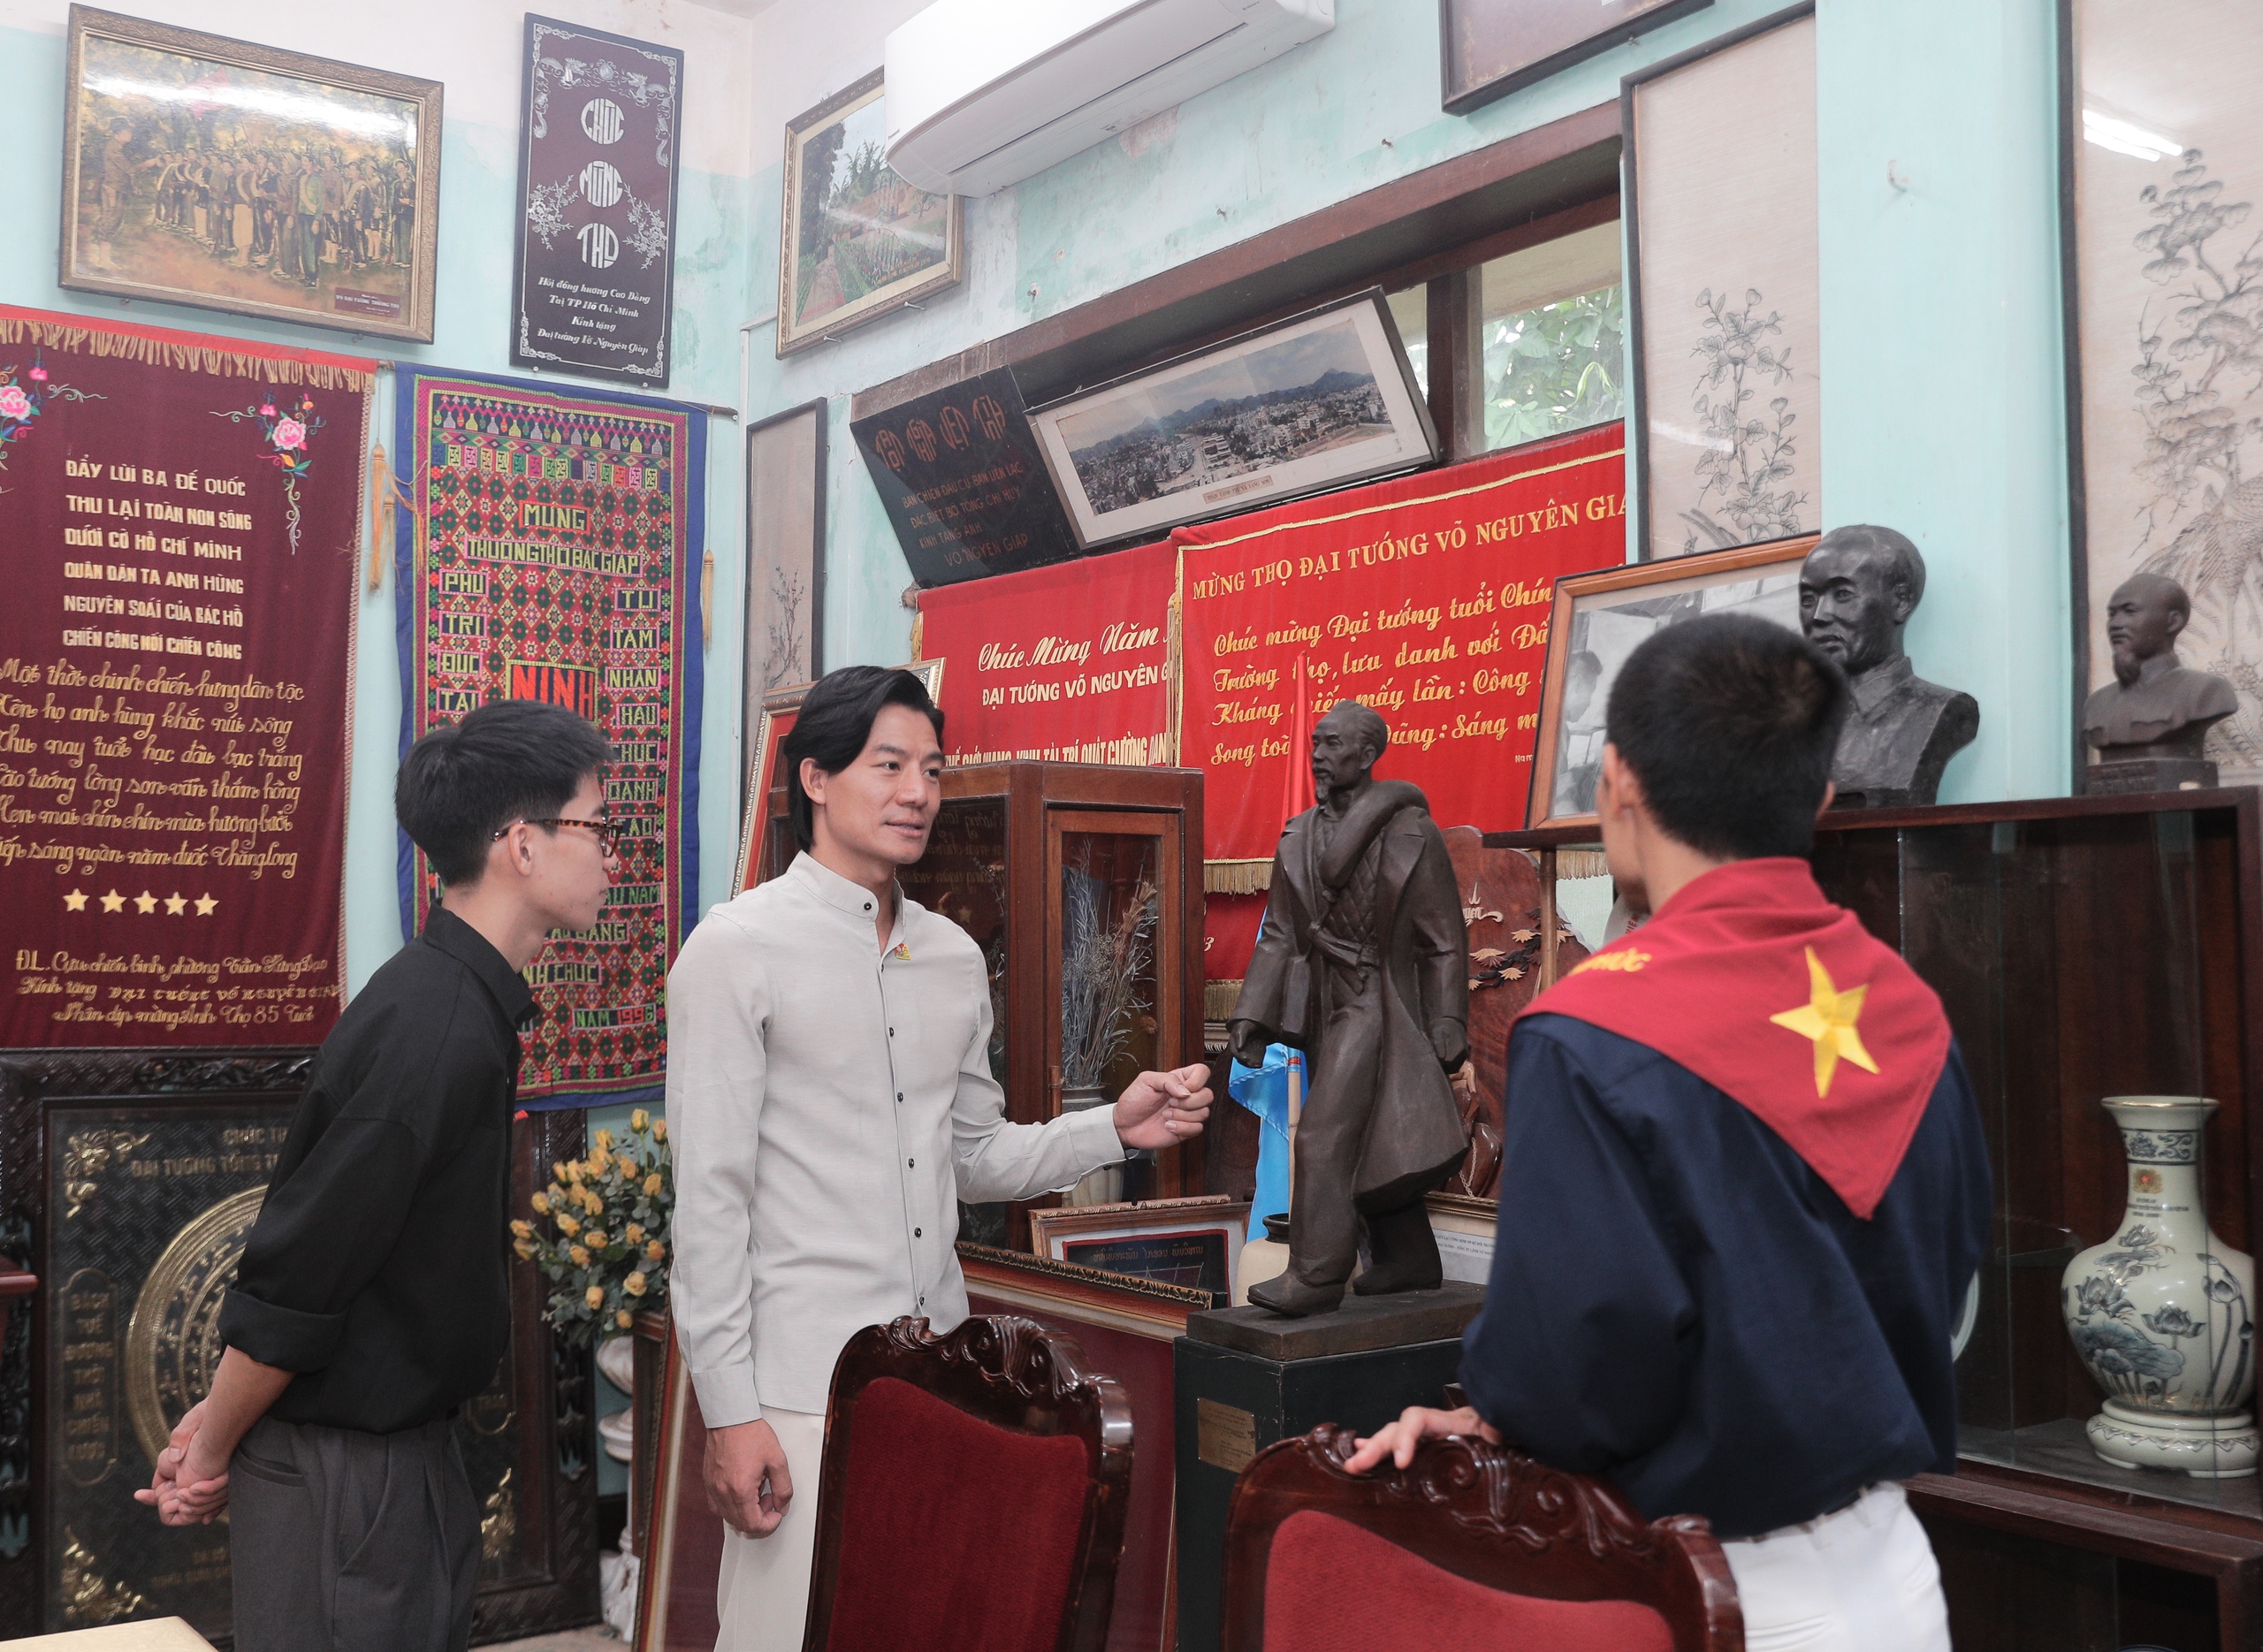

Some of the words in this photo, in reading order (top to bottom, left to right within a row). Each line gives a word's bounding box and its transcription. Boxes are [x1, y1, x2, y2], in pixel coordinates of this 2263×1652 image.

[567, 298, 583, 308] TP
[614, 307, 639, 318] Minh
[610, 289, 626, 299] Cao
[142, 468, 168, 487] BA
[176, 469, 199, 491] ĐẾ
[204, 476, 246, 497] QUỐC
[65, 494, 103, 514] THU
[144, 501, 184, 523] TOÀN
[187, 507, 215, 527] NON
[218, 510, 252, 530] SÔNG
[523, 503, 586, 530] MUNG
[134, 530, 156, 552] HỒ
[1192, 571, 1246, 600] MỪNG
[1252, 559, 1293, 586] THỌ
[1299, 551, 1341, 581] ĐẠI
[1348, 530, 1429, 569] TƯỚNG
[1435, 520, 1467, 552] VÕ
[1475, 499, 1579, 545] NGUYÊN
[65, 561, 103, 580] QUÂN
[141, 568, 161, 585] TA
[165, 571, 199, 590] ANH
[203, 574, 244, 594] HÙNG
[444, 573, 484, 594] PHU
[64, 595, 124, 614] NGUYÊN
[165, 600, 193, 622] CỦA
[195, 605, 221, 625] BÁC
[223, 604, 244, 628] HỒ
[621, 590, 653, 609] TU
[446, 614, 481, 636] TRI
[1214, 625, 1258, 657] Chúc
[1265, 620, 1322, 648] mừng
[1327, 611, 1371, 643] Đại
[1377, 598, 1443, 631] tướng
[1449, 582, 1496, 620] tuổi
[63, 625, 103, 647] CHIẾN
[104, 630, 140, 650] CÔNG
[166, 636, 202, 656] CHIẾN
[206, 640, 242, 659] CÔNG
[613, 629, 653, 648] TAM
[978, 643, 1025, 672] Chúc
[1026, 636, 1092, 667] Mừng
[1099, 621, 1159, 655] Năm
[1213, 664, 1280, 692] Trường
[1342, 651, 1383, 675] lưu
[1395, 636, 1458, 667] danh
[1467, 621, 1502, 657] với
[0, 659, 41, 687] Một
[145, 666, 194, 697] chiến
[240, 674, 274, 699] dân
[276, 681, 305, 704] tộc
[512, 665, 595, 720] NINH
[609, 669, 657, 688] NHAN
[982, 687, 1004, 710] ĐẠI
[1010, 680, 1060, 704] TƯỚNG
[1065, 674, 1086, 698] VÕ
[1091, 663, 1159, 695] NGUYÊN
[440, 691, 476, 712] TAI
[1212, 697, 1283, 727] Kháng
[1472, 668, 1531, 697] Công
[42, 692, 65, 724] họ
[69, 696, 110, 723] anh
[112, 697, 156, 741] hùng
[161, 702, 205, 731] khắc
[210, 712, 246, 733] núi
[248, 717, 293, 747] sông
[621, 705, 656, 725] HAU
[1210, 742, 1255, 767] Song
[1452, 711, 1509, 741] Sáng
[44, 739, 86, 769] nay
[142, 734, 175, 765] hạc
[222, 739, 254, 768] bạc
[257, 745, 303, 781] trắng
[27, 767, 77, 805] tướng
[84, 763, 123, 809] lòng
[125, 778, 168, 796] son
[263, 773, 301, 814] hồng
[38, 808, 80, 826] mai
[80, 799, 123, 828] chín
[122, 803, 166, 831] chín
[165, 811, 206, 832] mùa
[74, 843, 126, 875] ngàn
[629, 885, 660, 903] NAM
[553, 964, 597, 982] CHUC
[253, 1004, 279, 1024] 85
[576, 1010, 610, 1027] NAM
[618, 1006, 653, 1024] 1996
